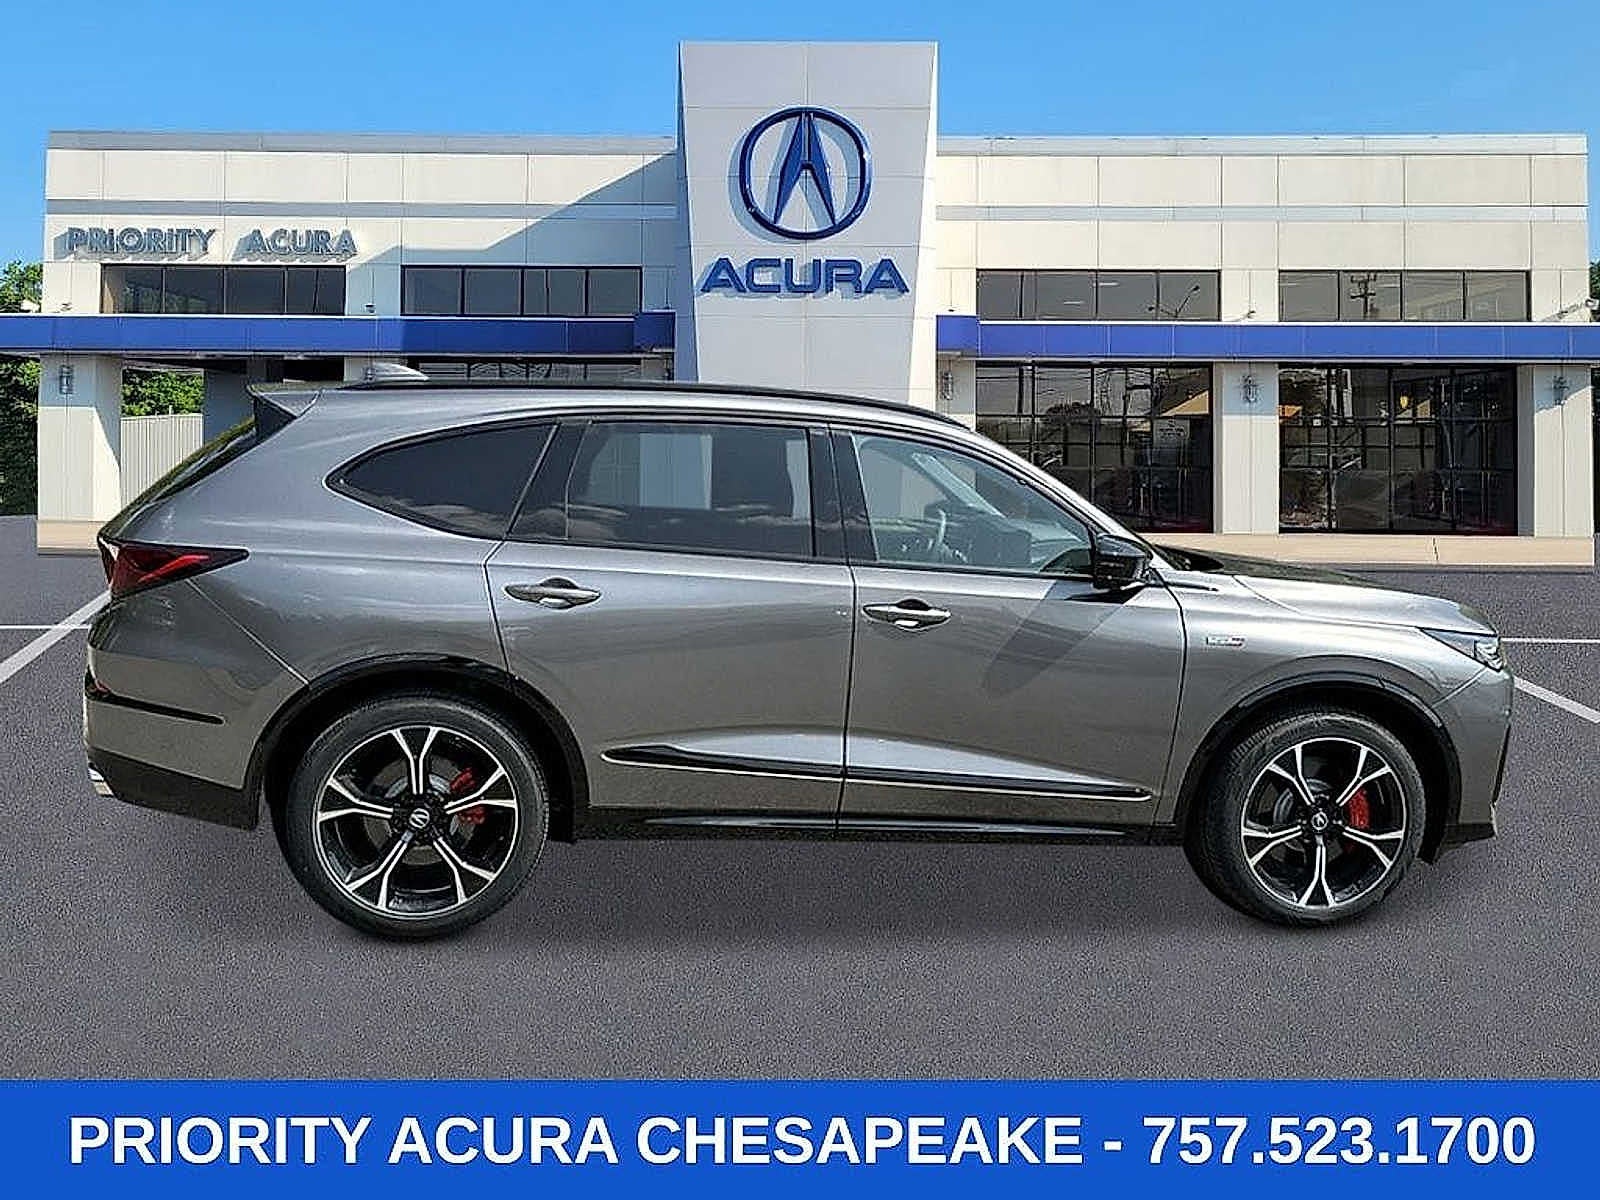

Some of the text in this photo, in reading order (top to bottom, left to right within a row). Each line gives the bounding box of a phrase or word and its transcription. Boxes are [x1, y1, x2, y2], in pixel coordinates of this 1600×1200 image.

[67, 227, 358, 254] PRIORITY ACURA
[700, 257, 910, 294] ACURA
